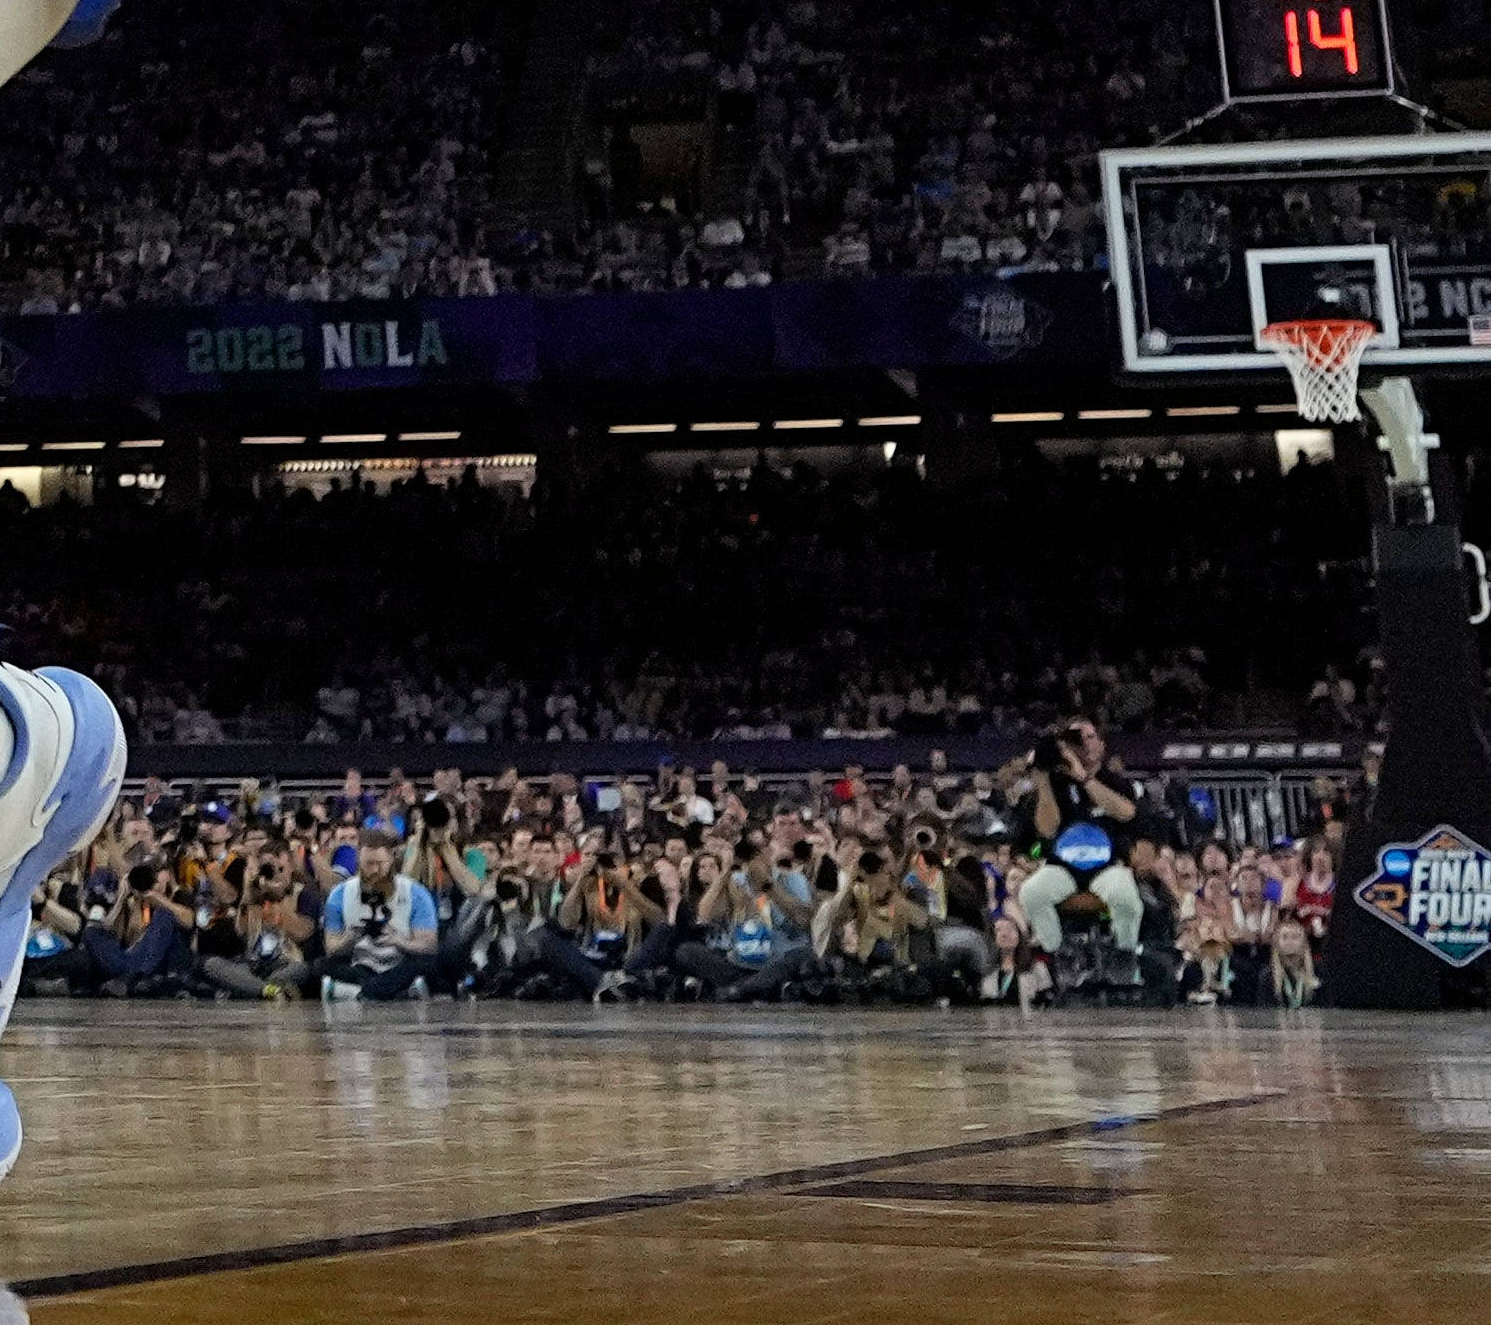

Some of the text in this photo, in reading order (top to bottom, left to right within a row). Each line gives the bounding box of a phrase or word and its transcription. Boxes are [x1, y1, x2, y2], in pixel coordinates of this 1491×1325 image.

[1284, 6, 1360, 78] 14
[185, 316, 450, 375] 2022 NOLA
[1408, 892, 1491, 926] FOUR
